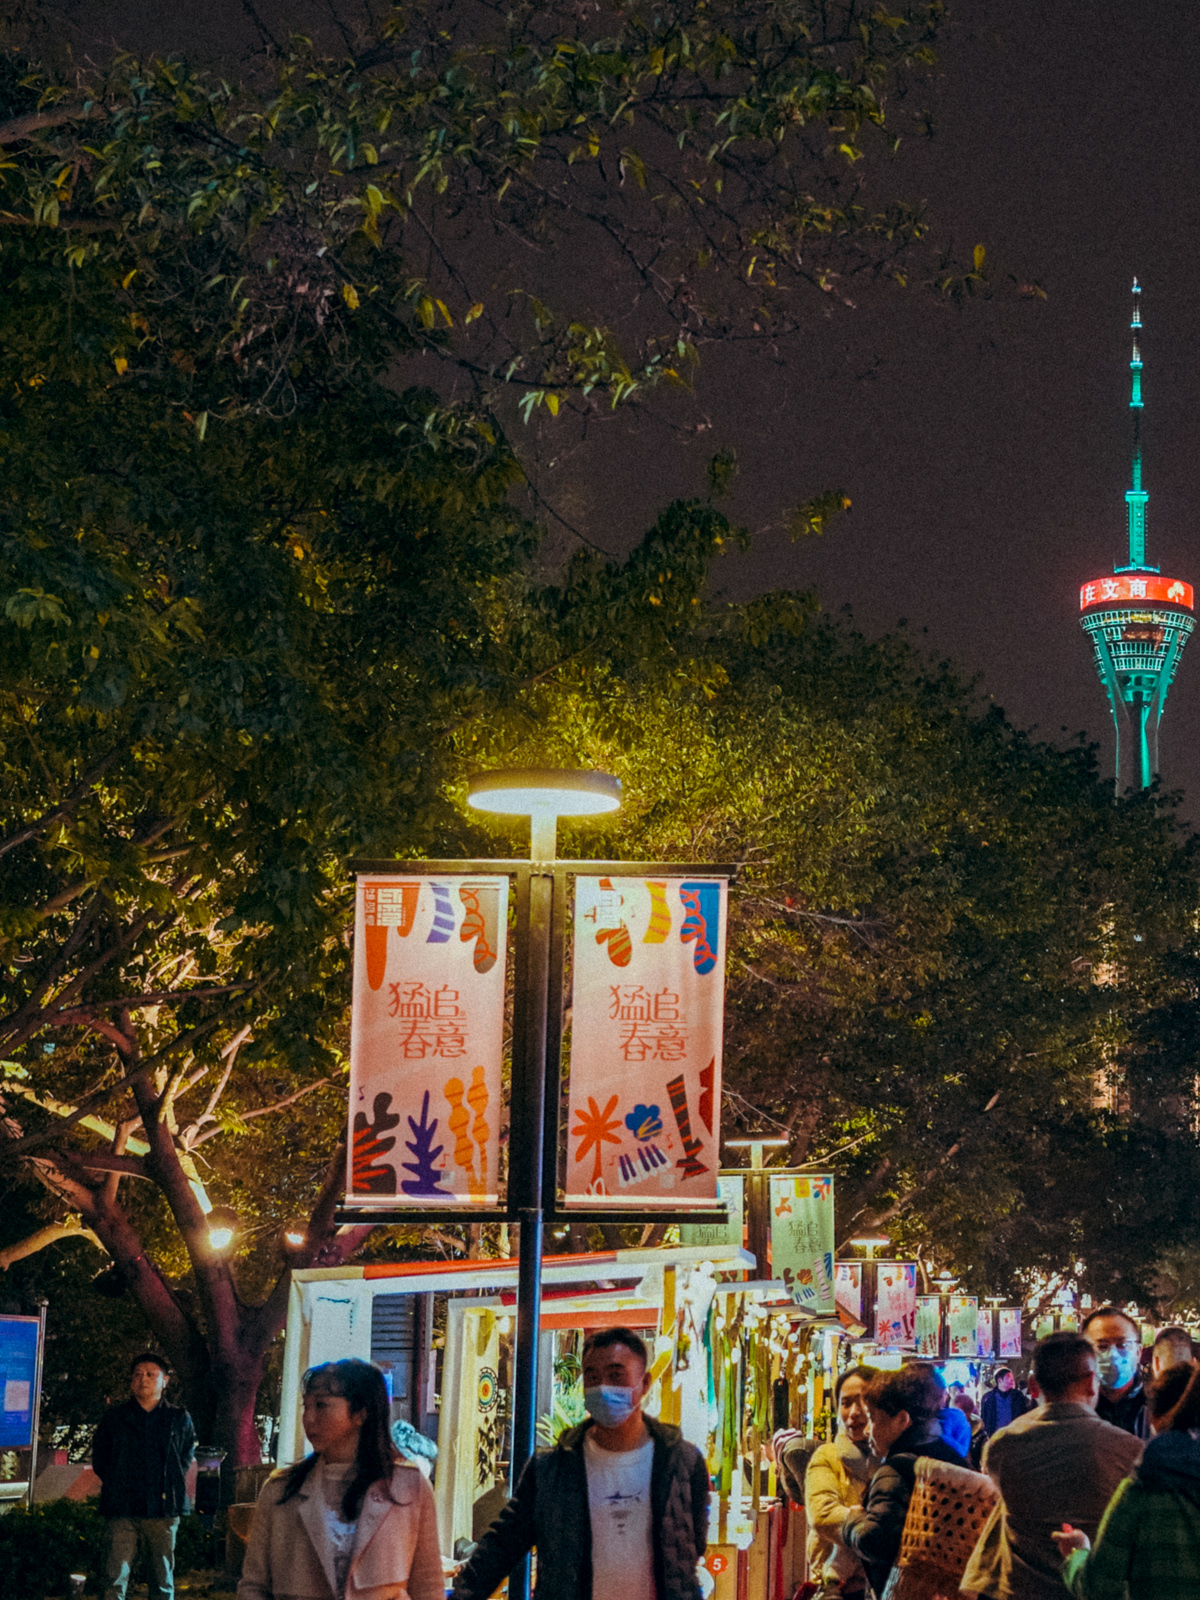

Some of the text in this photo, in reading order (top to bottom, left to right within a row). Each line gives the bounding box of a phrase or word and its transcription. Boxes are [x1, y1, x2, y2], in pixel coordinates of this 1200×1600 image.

[388, 982, 467, 1020] 猛追
[608, 985, 688, 1023] 猛追
[399, 1019, 469, 1059] 春意
[619, 1022, 689, 1061] 春意
[712, 1558, 722, 1571] 5
